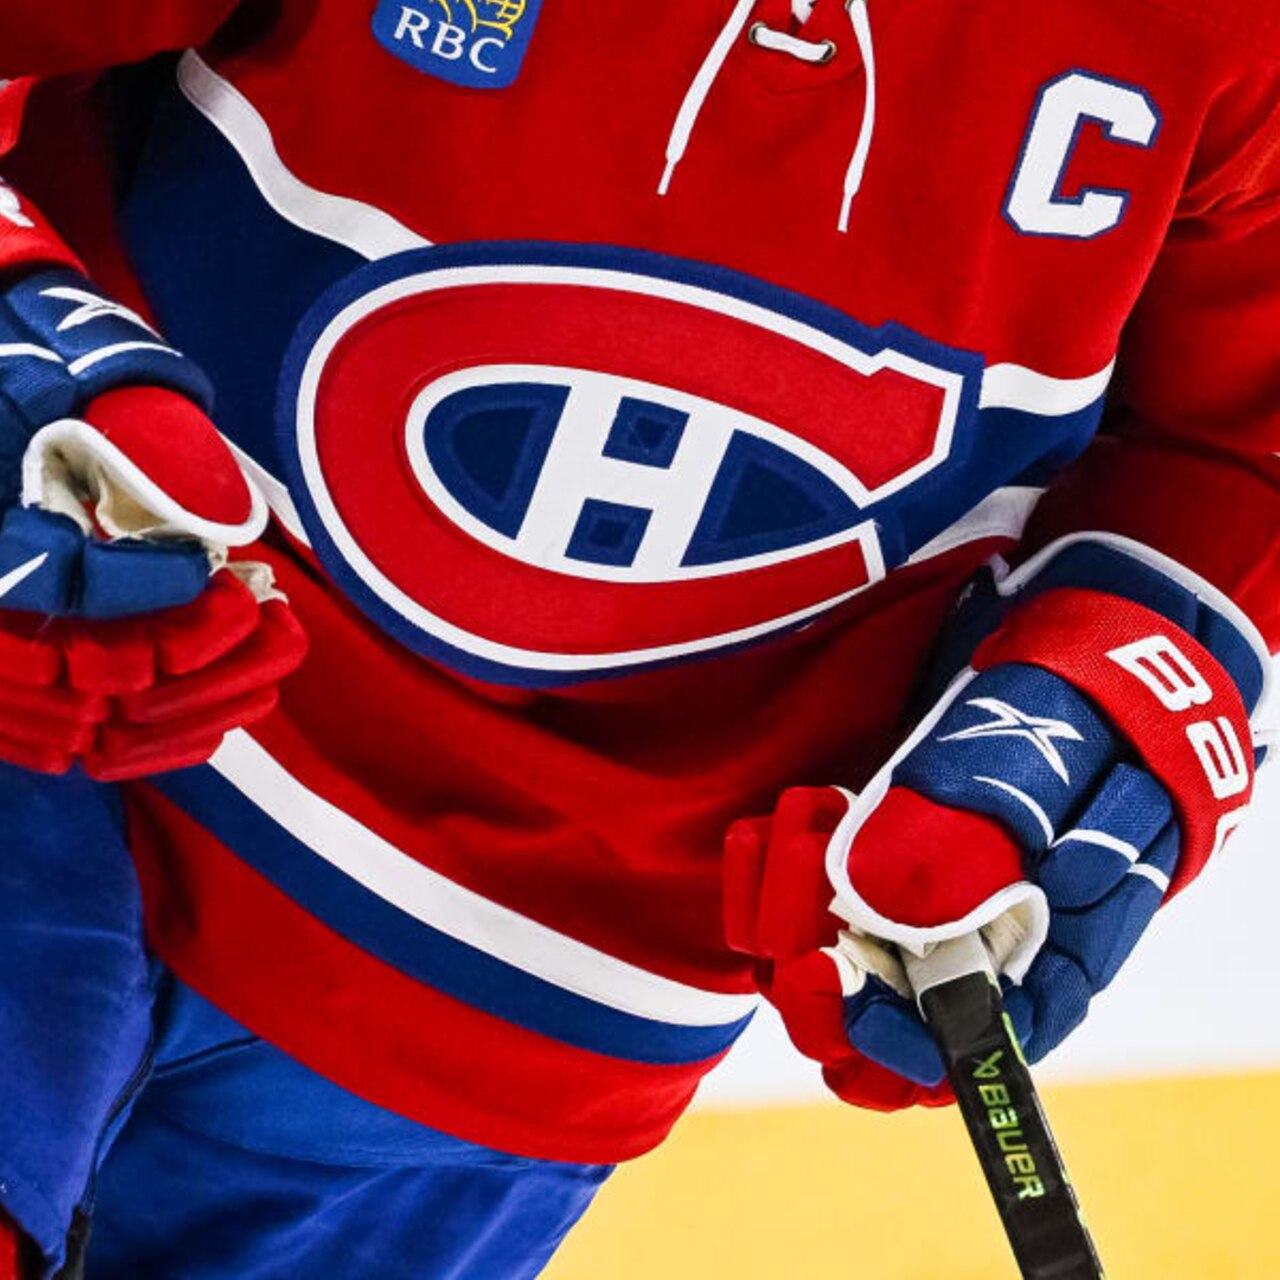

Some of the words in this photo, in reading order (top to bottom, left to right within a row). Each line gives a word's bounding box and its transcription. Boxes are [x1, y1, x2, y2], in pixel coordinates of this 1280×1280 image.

[393, 6, 505, 73] RBC
[1001, 68, 1164, 241] C
[978, 1083, 1047, 1200] BAUER
